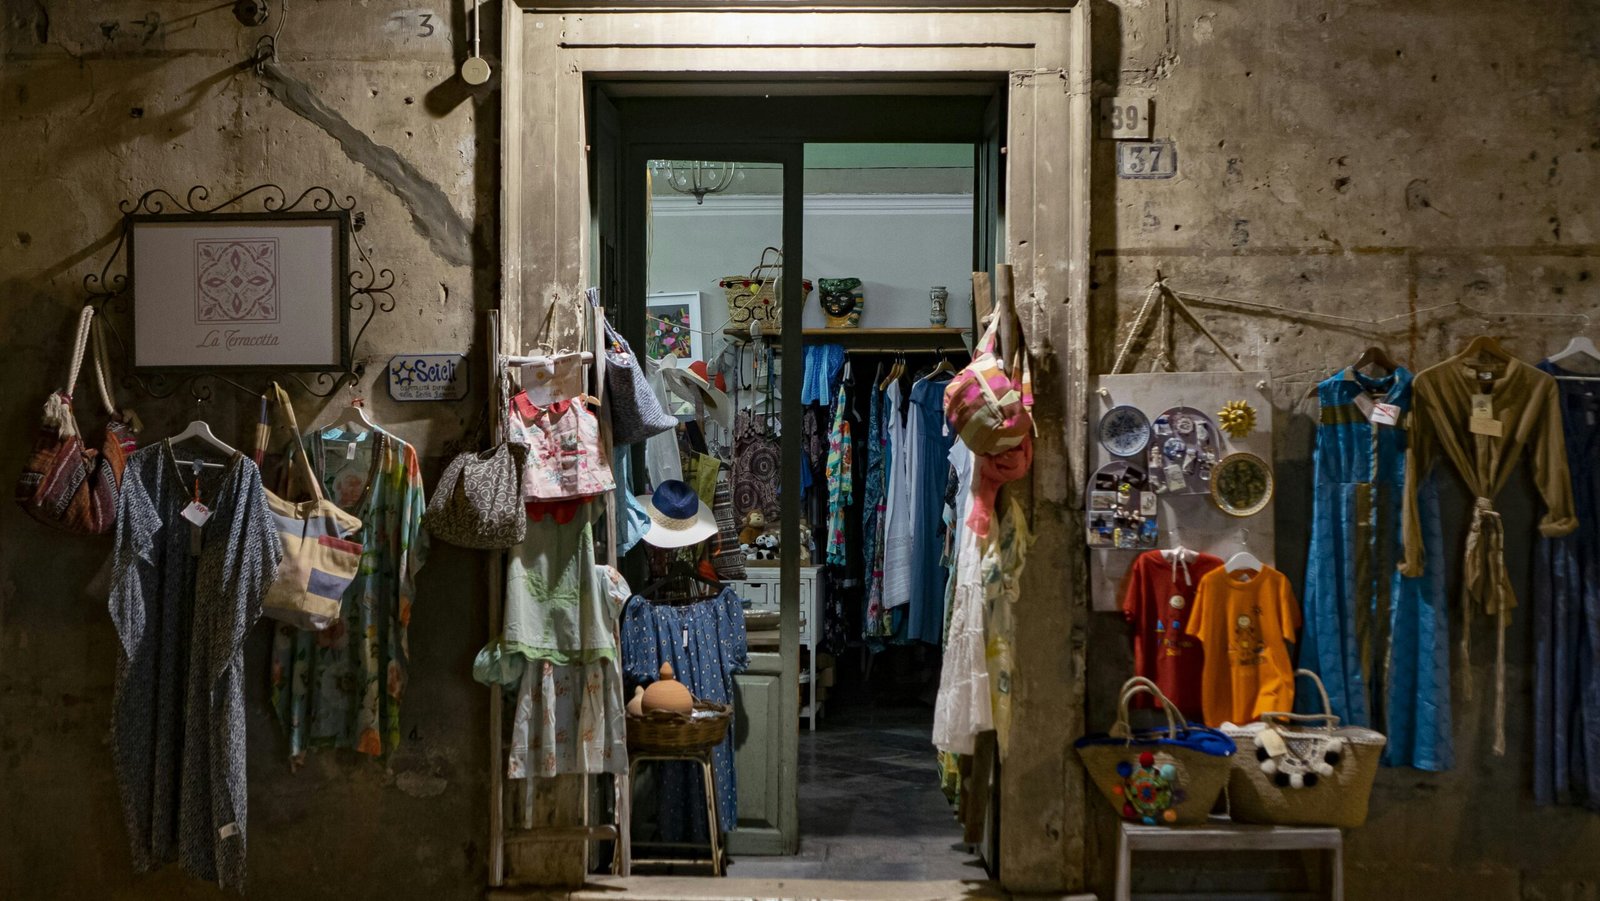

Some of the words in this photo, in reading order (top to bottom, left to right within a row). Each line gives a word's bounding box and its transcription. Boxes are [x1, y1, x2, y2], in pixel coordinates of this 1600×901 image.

[1111, 105, 1138, 130] 39
[1130, 146, 1164, 173] 37
[195, 329, 220, 348] La
[224, 329, 280, 351] Terracotta
[414, 359, 457, 384] Scicli
